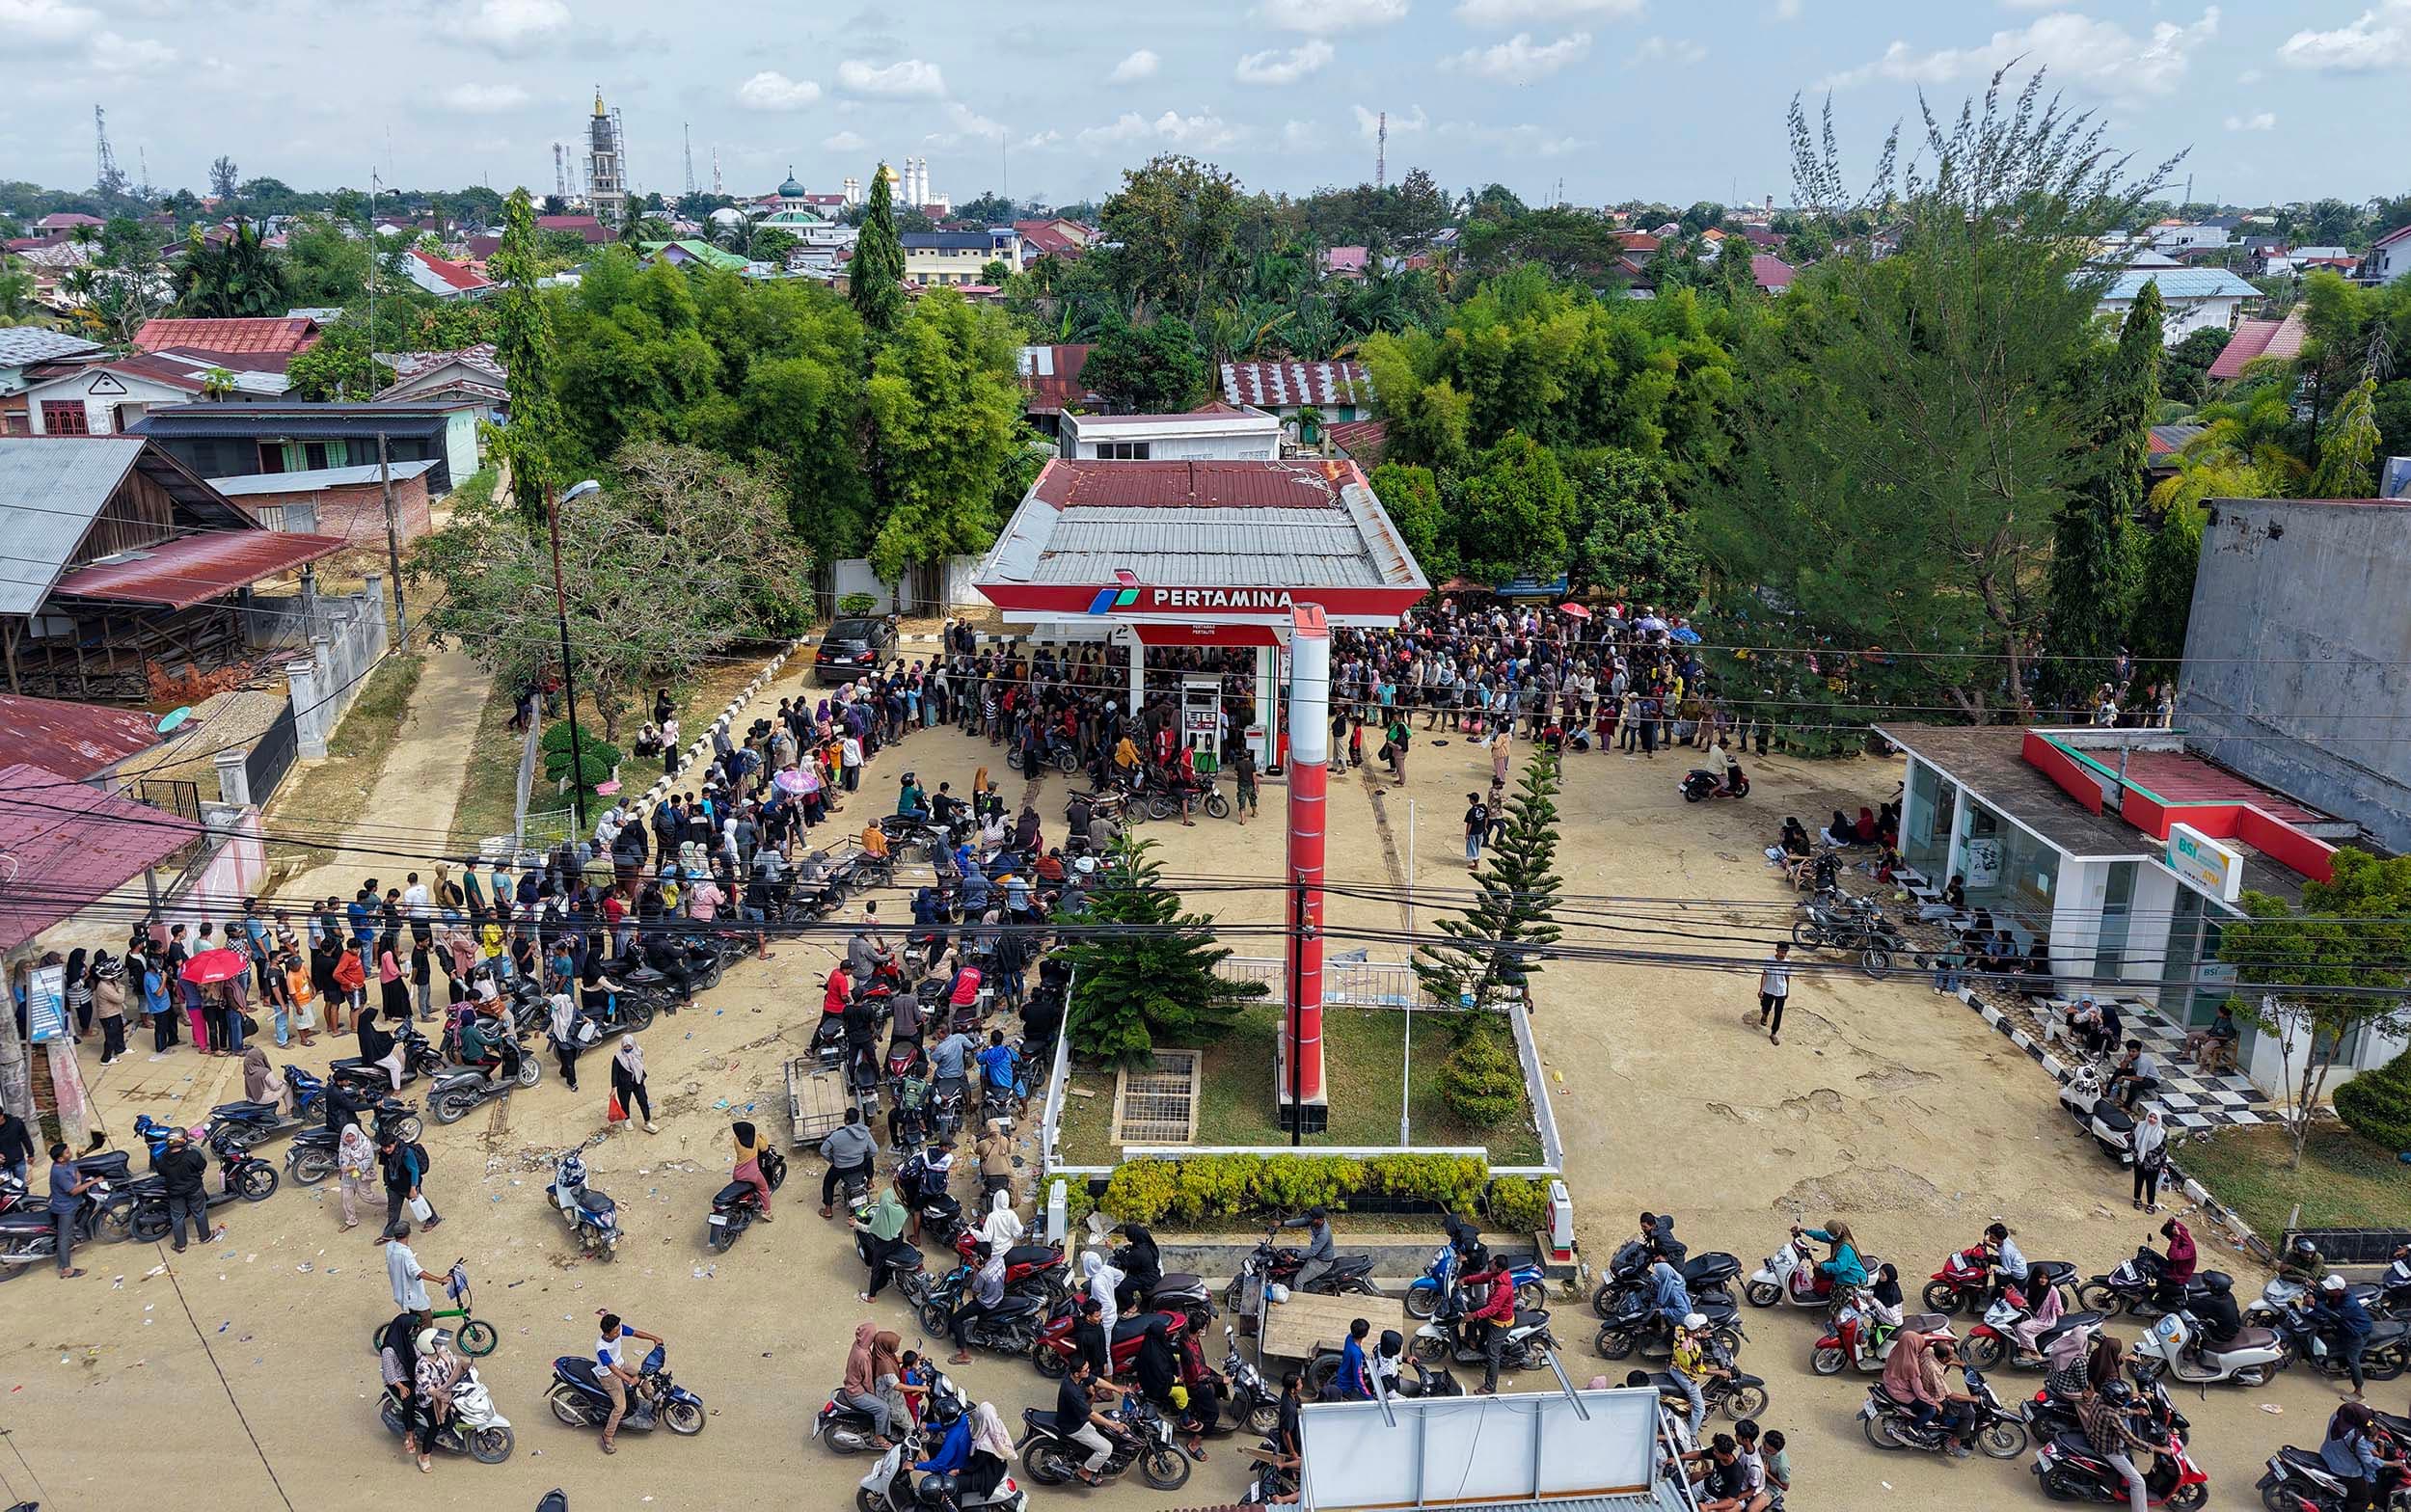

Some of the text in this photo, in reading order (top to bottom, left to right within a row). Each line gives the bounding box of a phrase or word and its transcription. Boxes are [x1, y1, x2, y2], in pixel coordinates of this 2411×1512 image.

[1153, 589, 1293, 608] PERTAMINA
[2179, 837, 2198, 859] BSI
[2202, 870, 2220, 885] ATM
[2204, 967, 2218, 976] BSI
